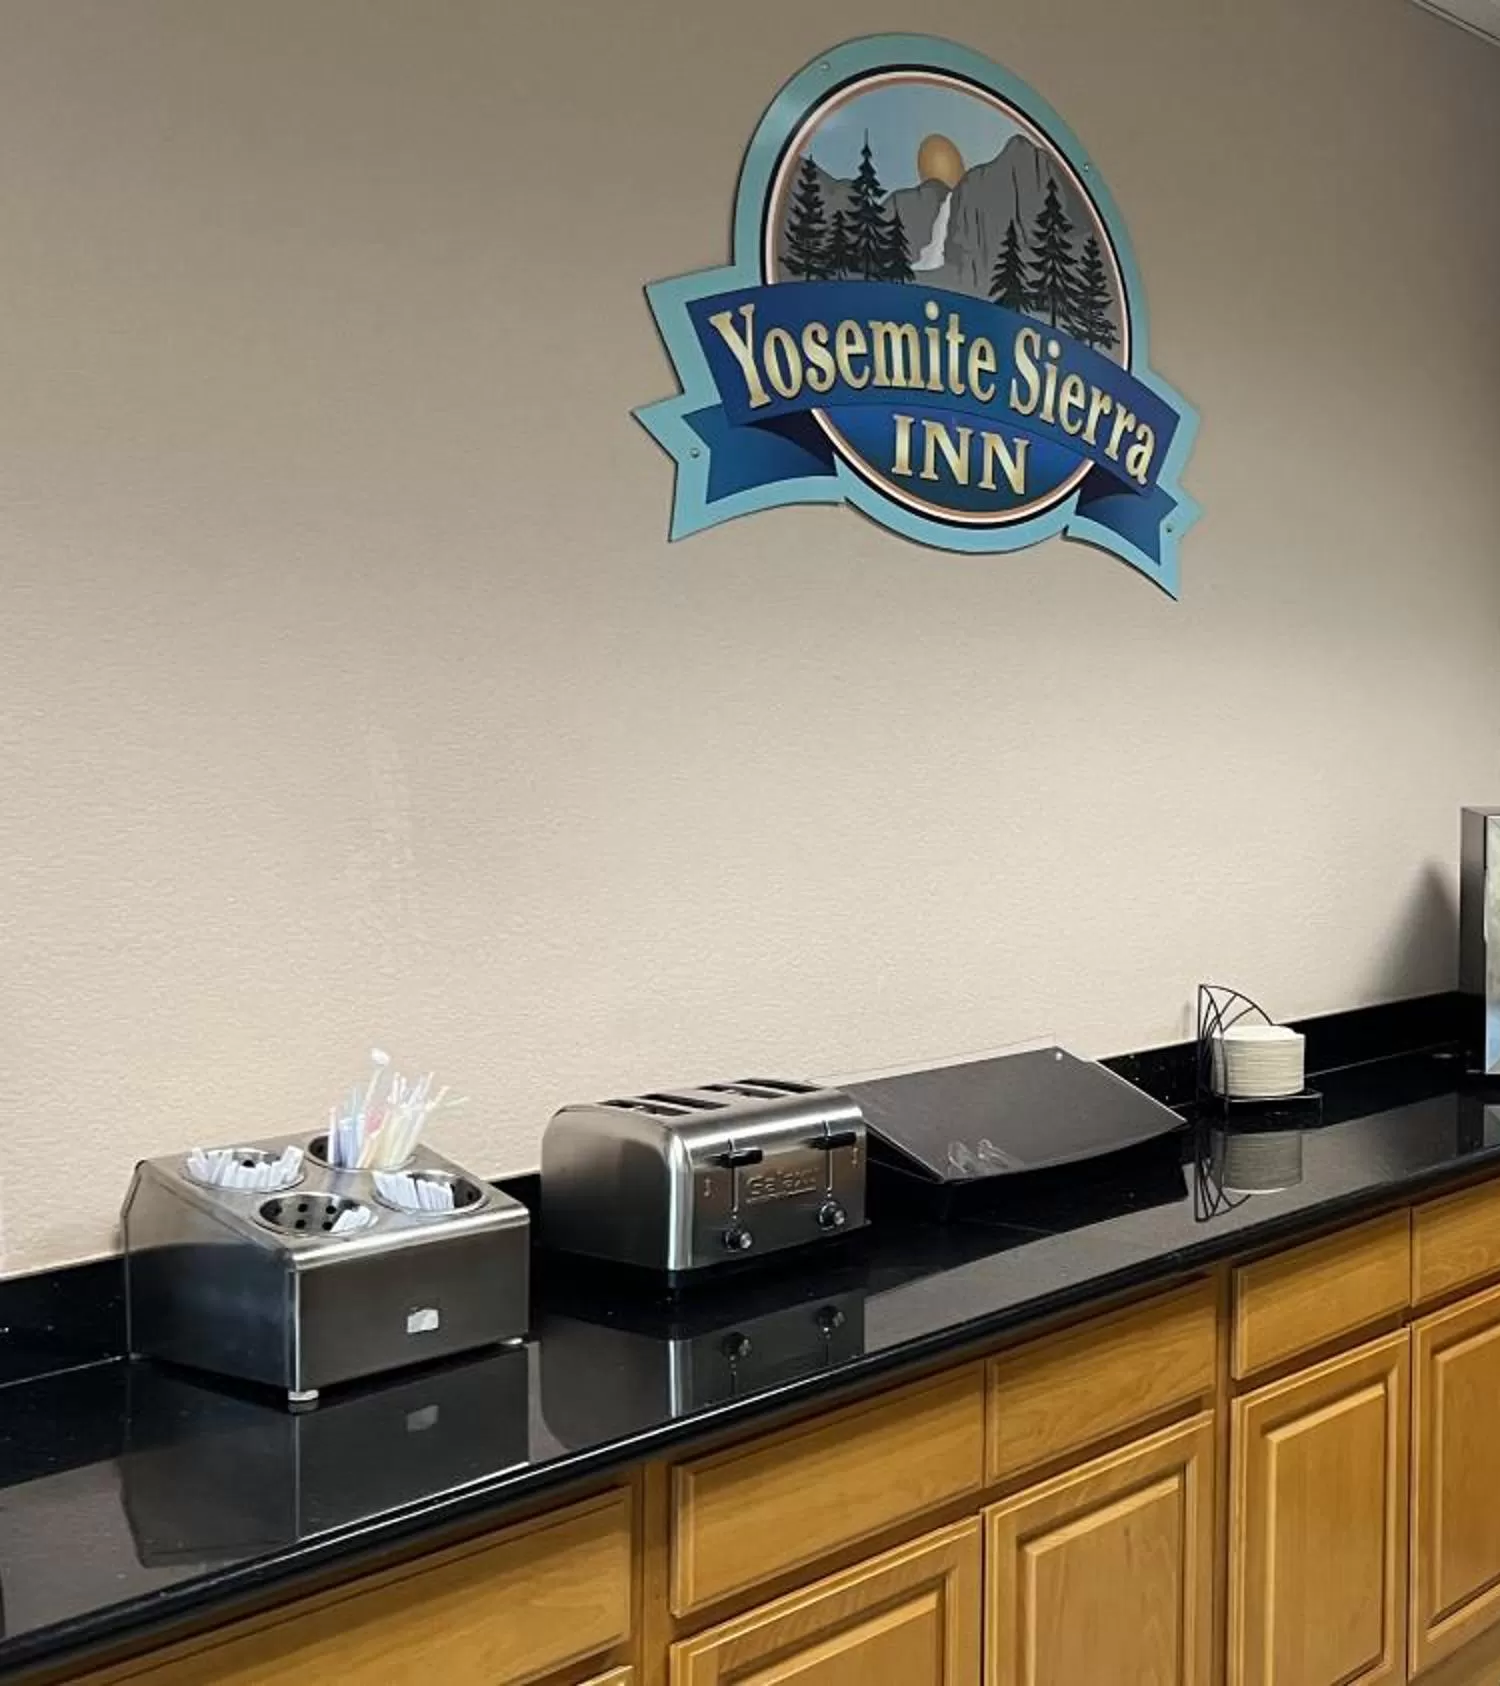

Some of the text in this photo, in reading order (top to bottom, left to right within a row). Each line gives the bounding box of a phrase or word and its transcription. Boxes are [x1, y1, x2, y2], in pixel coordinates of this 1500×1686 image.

[709, 302, 1157, 485] Yosemite Sierra
[892, 414, 1030, 495] INN
